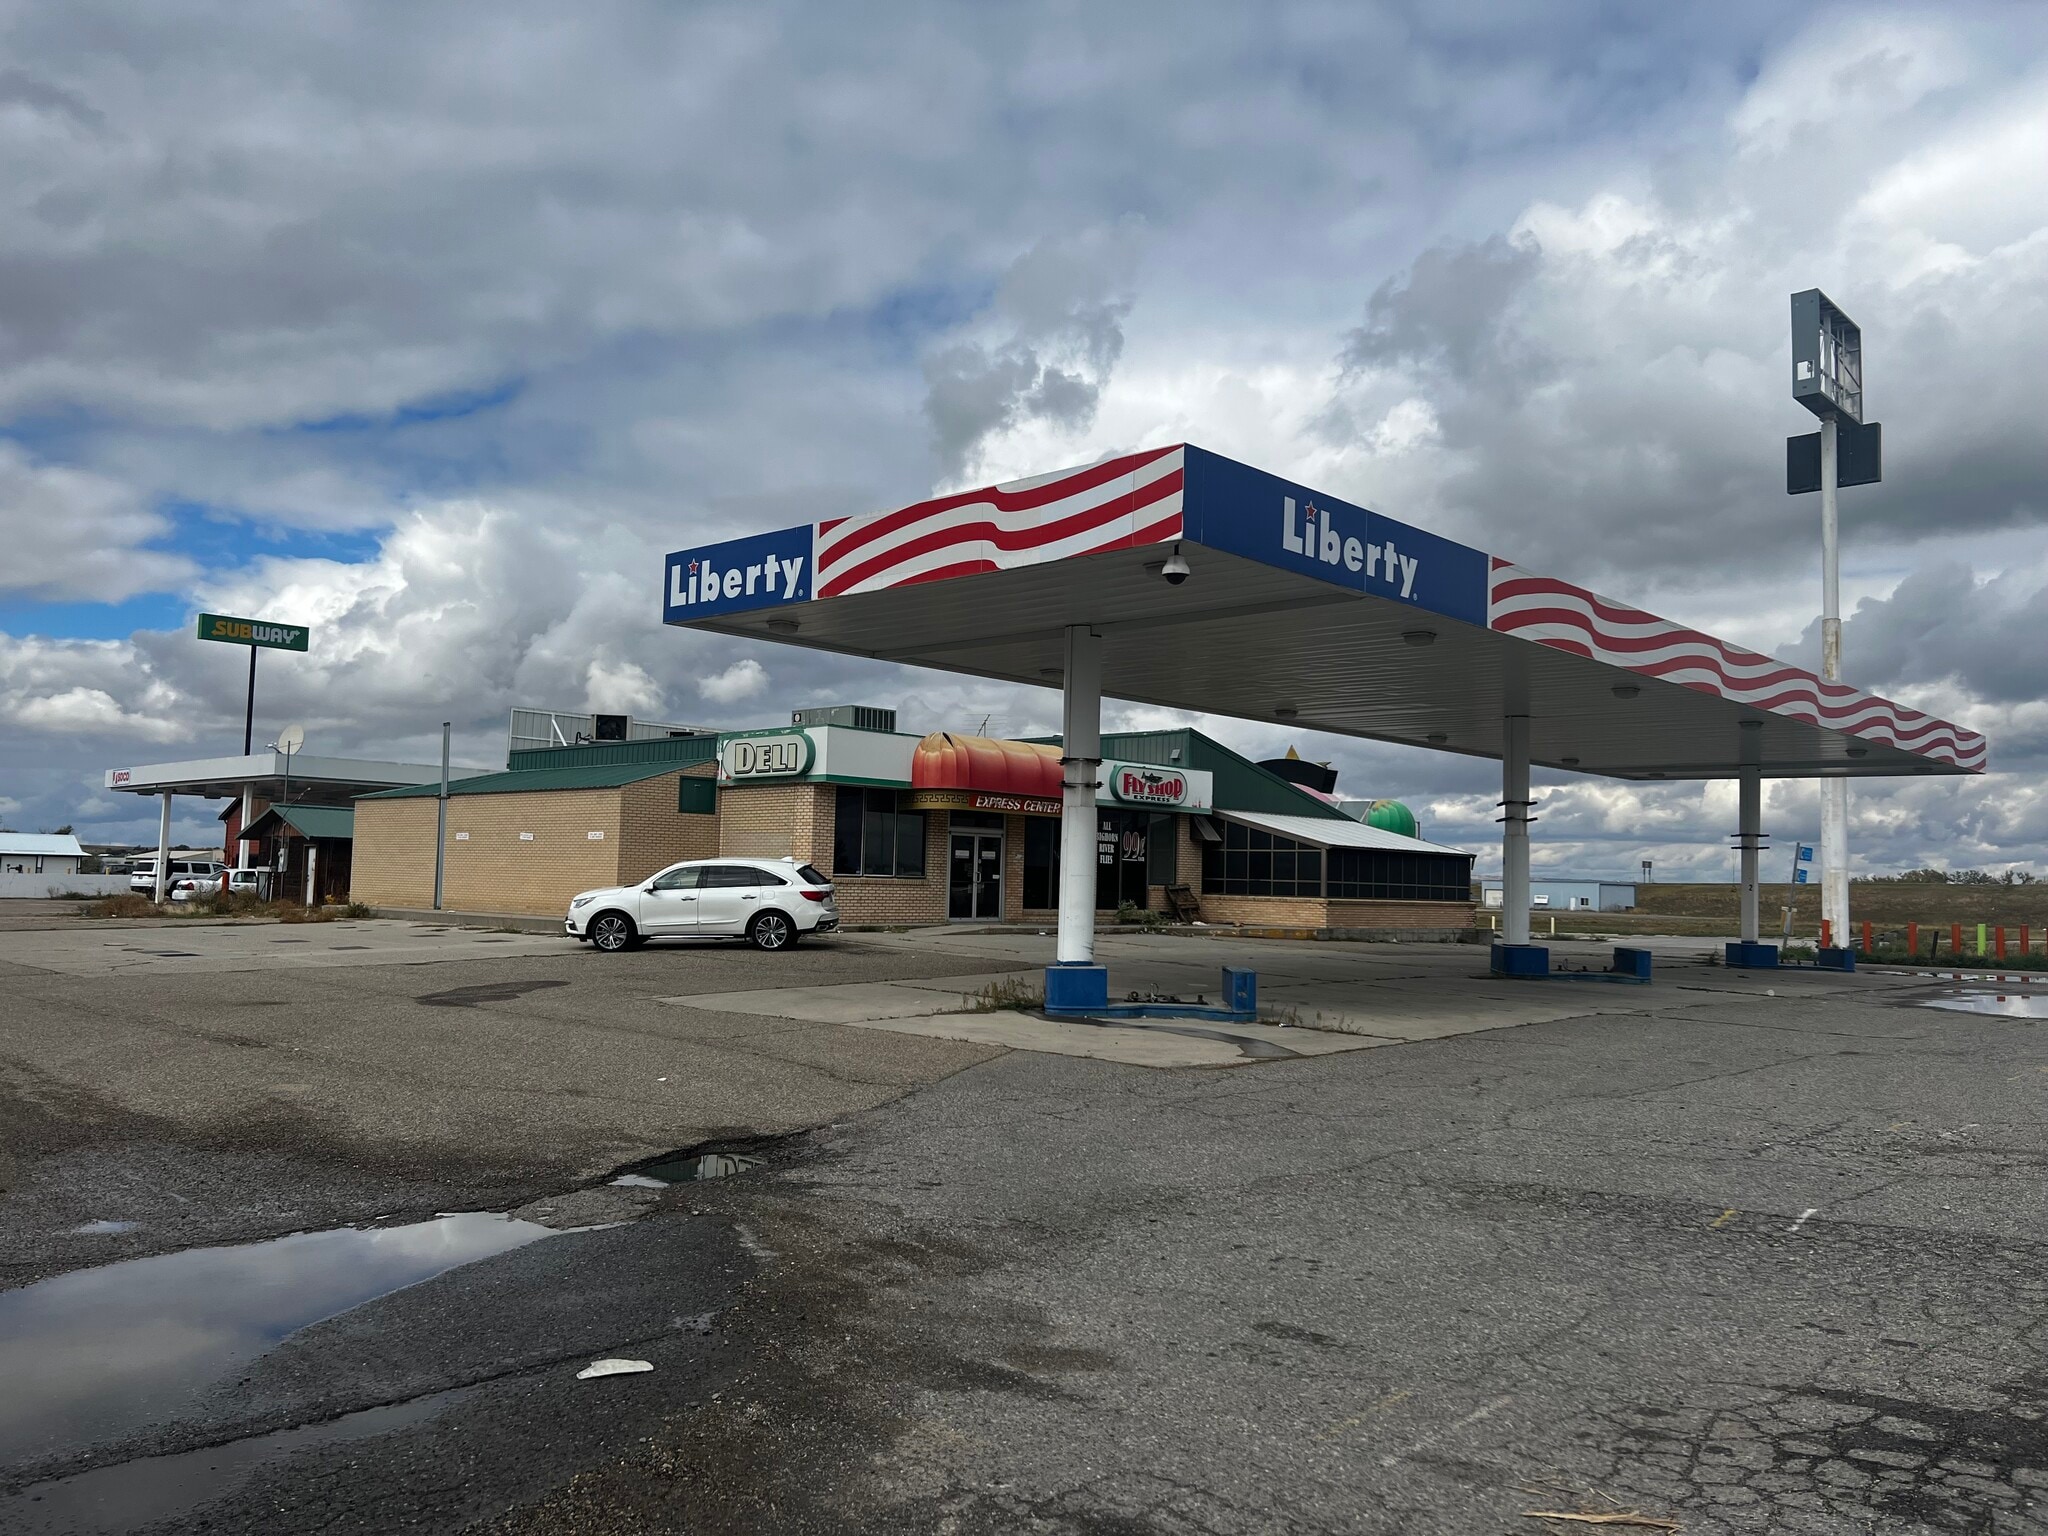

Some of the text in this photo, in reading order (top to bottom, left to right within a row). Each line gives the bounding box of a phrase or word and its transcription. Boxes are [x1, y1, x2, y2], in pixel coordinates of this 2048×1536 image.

[1282, 495, 1418, 599] Liberty
[670, 554, 804, 607] Liberty
[211, 620, 301, 644] SUBWAY
[735, 742, 798, 774] DELI
[1123, 772, 1183, 801] FLY SHOP
[976, 795, 1061, 813] EXPRESS CENTER
[1102, 821, 1112, 831] ALL
[1098, 843, 1115, 853] RIVER
[1099, 854, 1113, 864] FLIES
